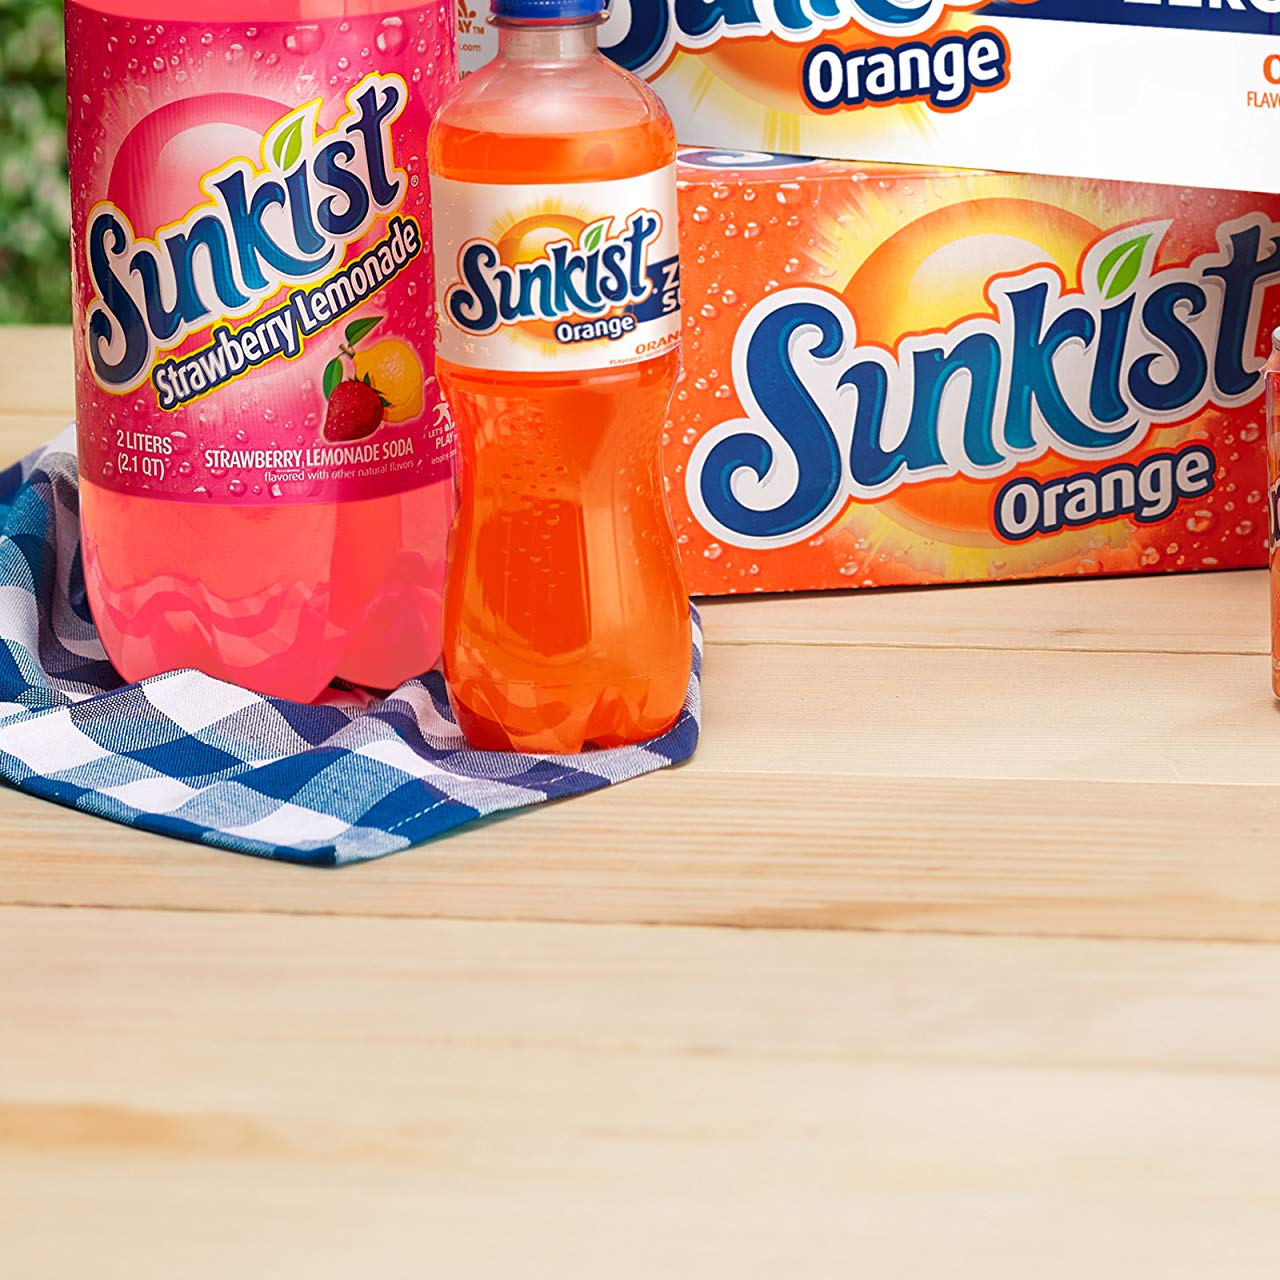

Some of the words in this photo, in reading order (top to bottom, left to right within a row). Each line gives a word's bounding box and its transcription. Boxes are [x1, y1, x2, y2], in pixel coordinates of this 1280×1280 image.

[806, 37, 1001, 102] Orange
[90, 85, 399, 383] Sunkist
[450, 215, 657, 330] Sunkist
[156, 307, 294, 405] Strawberry
[295, 221, 418, 335] Lemonade
[556, 317, 634, 341] Orange
[635, 330, 679, 354] ORAN
[117, 430, 124, 448] 2
[126, 433, 172, 455] LITERS
[205, 449, 302, 469] STRAWBERRY
[305, 445, 380, 466] LEMONADE
[383, 437, 414, 460] SODA
[435, 431, 453, 449] PLAY
[117, 453, 140, 473] (2.1
[142, 458, 166, 481] QT)
[264, 470, 305, 482] flavored
[307, 469, 329, 481] with
[332, 467, 355, 479] other
[357, 464, 387, 477] natural
[389, 461, 415, 473] flavors
[1000, 449, 1212, 535] Orange
